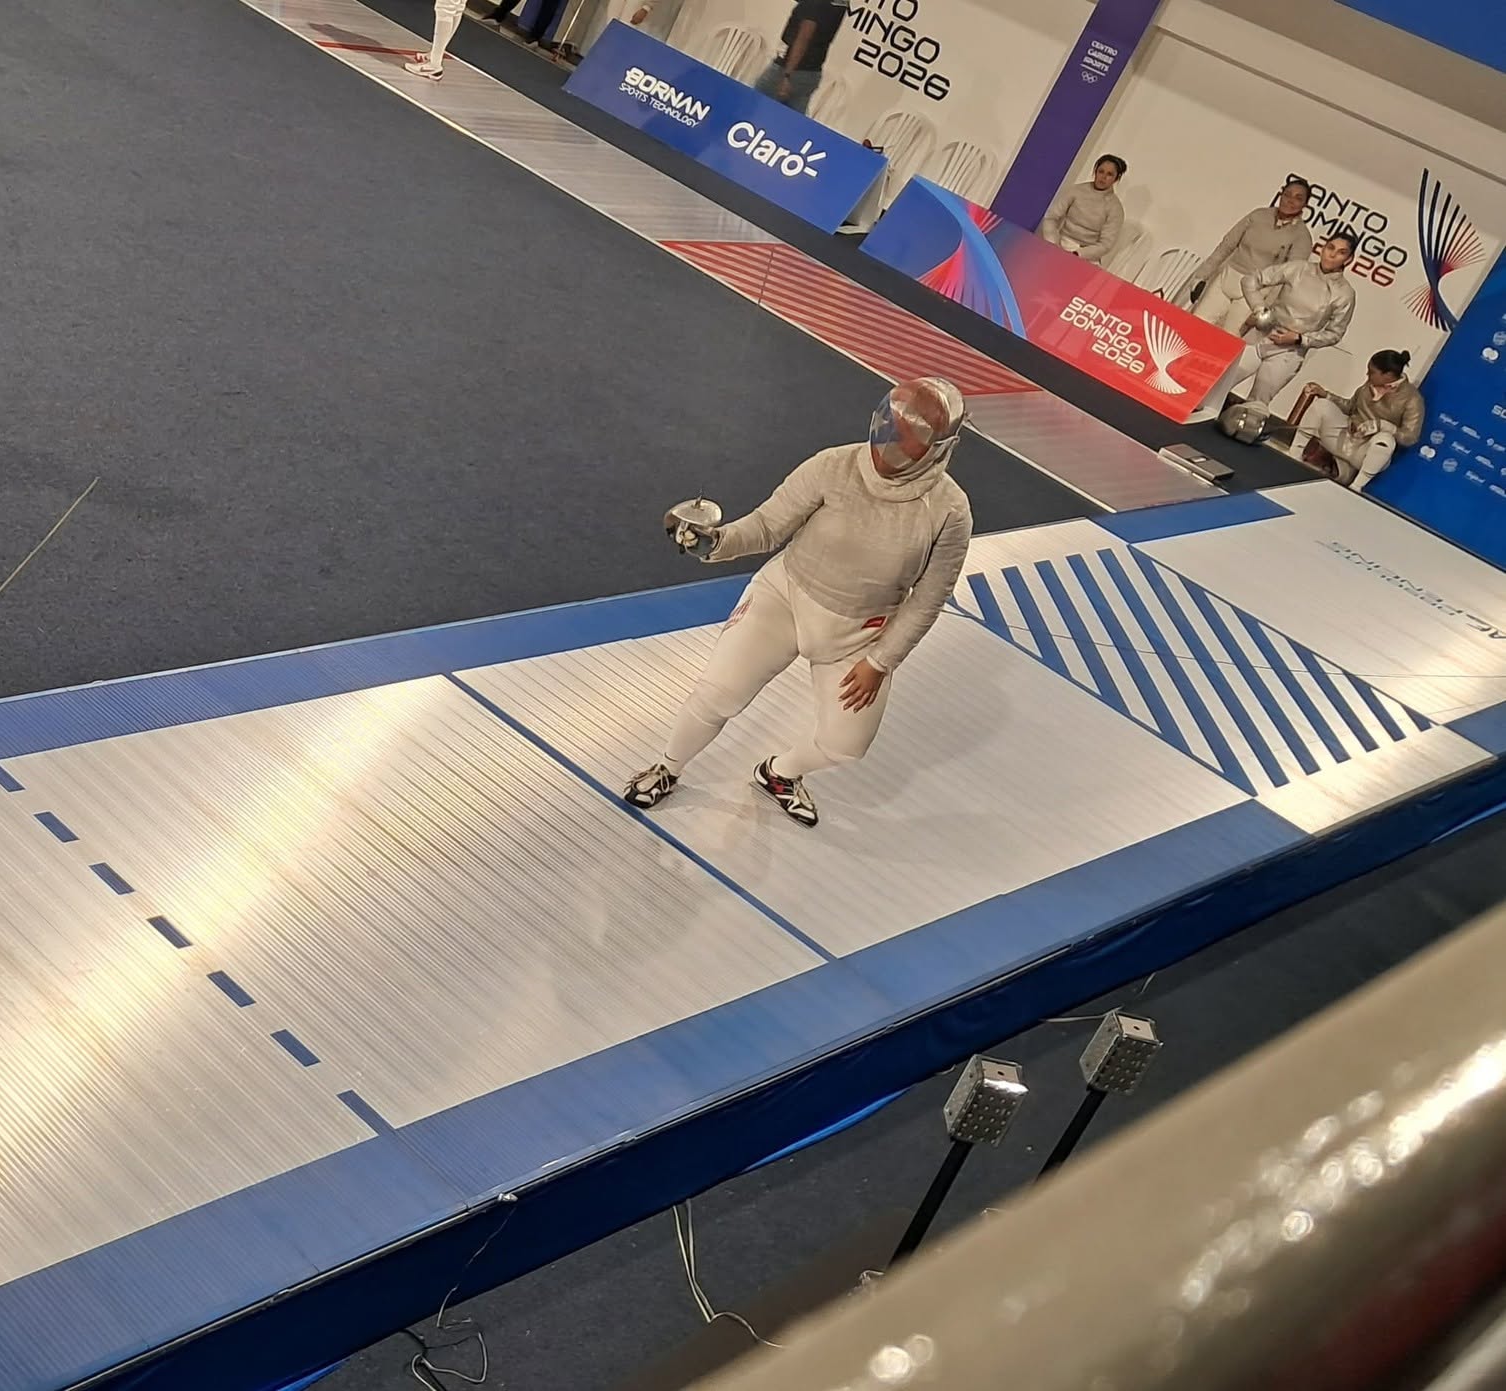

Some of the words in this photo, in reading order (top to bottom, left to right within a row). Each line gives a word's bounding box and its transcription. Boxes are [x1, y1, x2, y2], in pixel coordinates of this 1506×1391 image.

[846, 7, 941, 65] MINGO
[625, 66, 711, 121] BORNAN
[853, 38, 951, 101] 2026
[618, 82, 649, 103] SPORTS
[649, 96, 702, 128] TECHNOLOGY
[727, 121, 805, 177] Claro
[1059, 307, 1142, 357] DOMINGO
[1068, 296, 1133, 336] SANTO
[1091, 339, 1145, 374] 2026
